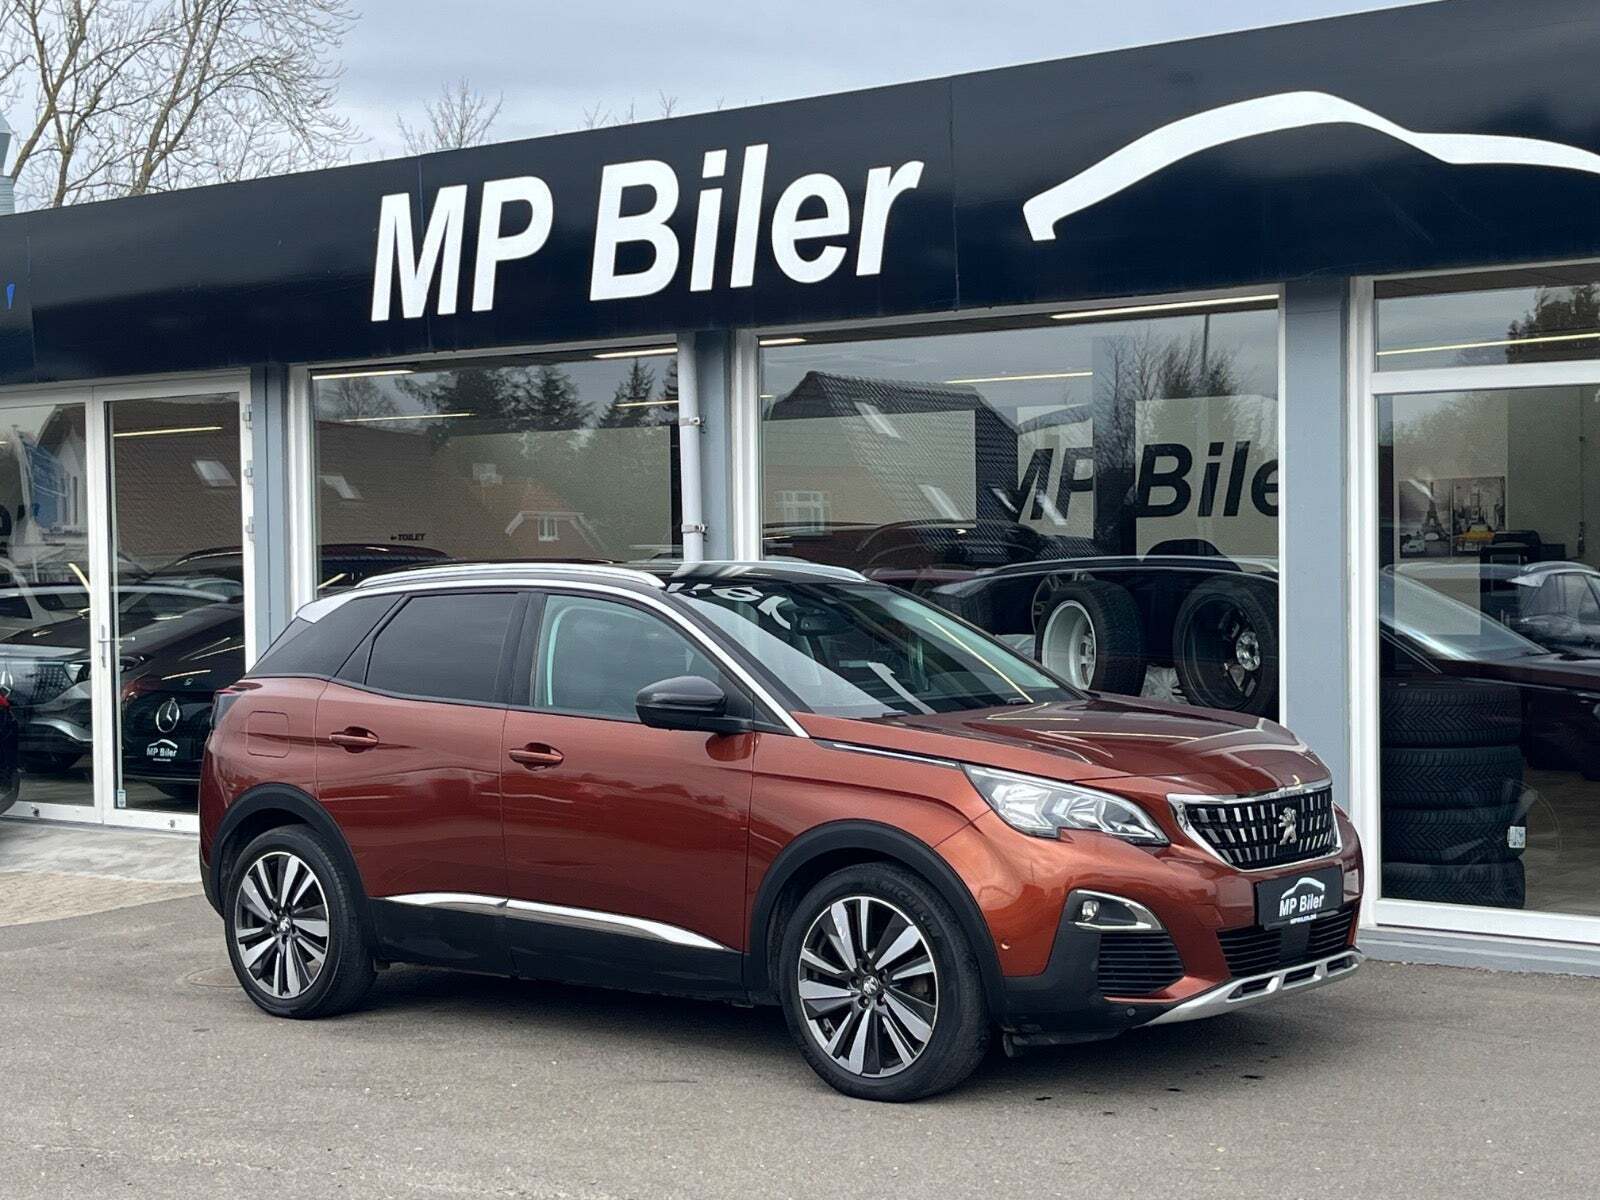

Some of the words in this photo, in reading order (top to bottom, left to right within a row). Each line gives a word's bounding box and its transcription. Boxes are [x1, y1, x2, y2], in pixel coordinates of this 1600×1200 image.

[370, 176, 554, 322] MP
[589, 144, 925, 301] Biler
[398, 532, 426, 541] TOILET
[147, 747, 158, 757] MP
[159, 747, 177, 757] Biler
[1279, 897, 1298, 917] MP
[1299, 893, 1325, 913] Biler
